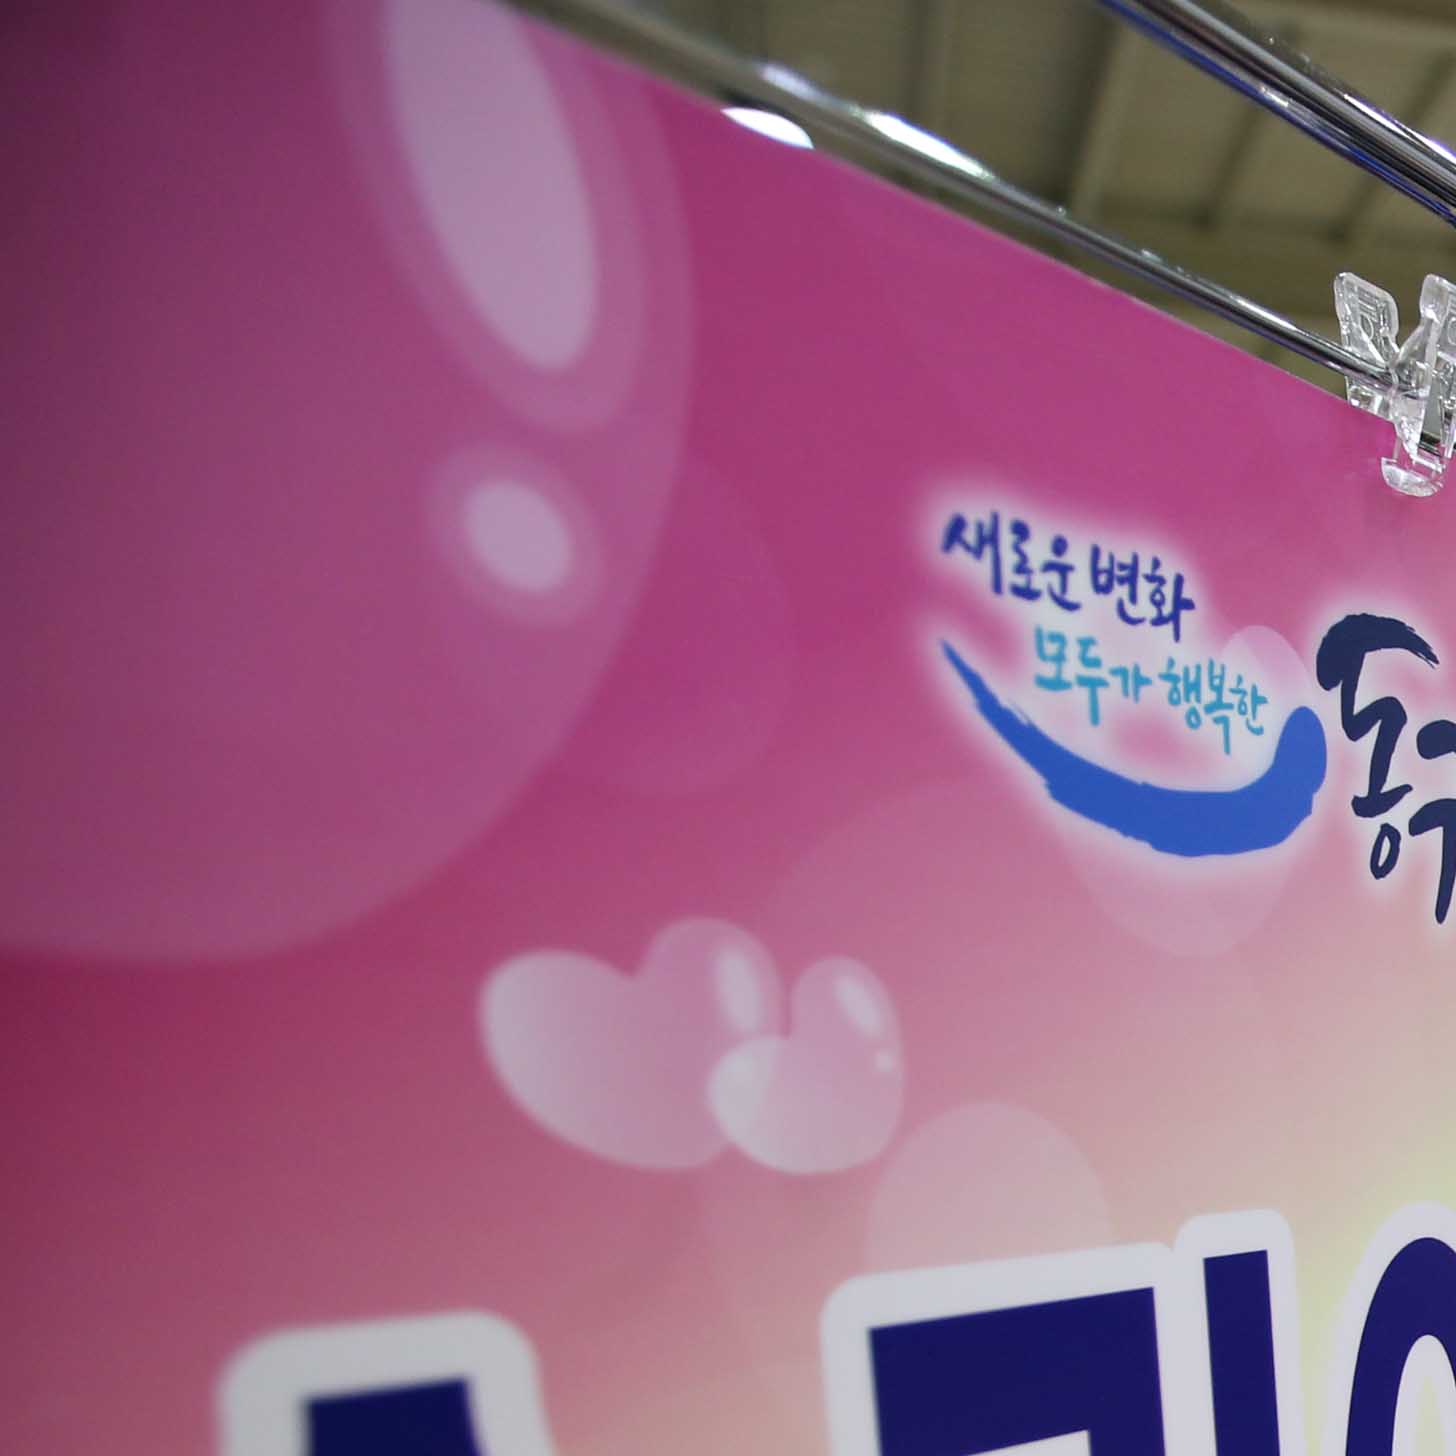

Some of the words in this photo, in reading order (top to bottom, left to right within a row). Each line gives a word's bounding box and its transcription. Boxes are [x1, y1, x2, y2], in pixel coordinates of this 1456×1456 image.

[940, 511, 1081, 612] 새로운
[1090, 545, 1196, 643] 변화
[1033, 625, 1152, 727] 모두가
[1157, 658, 1269, 755] 행복한
